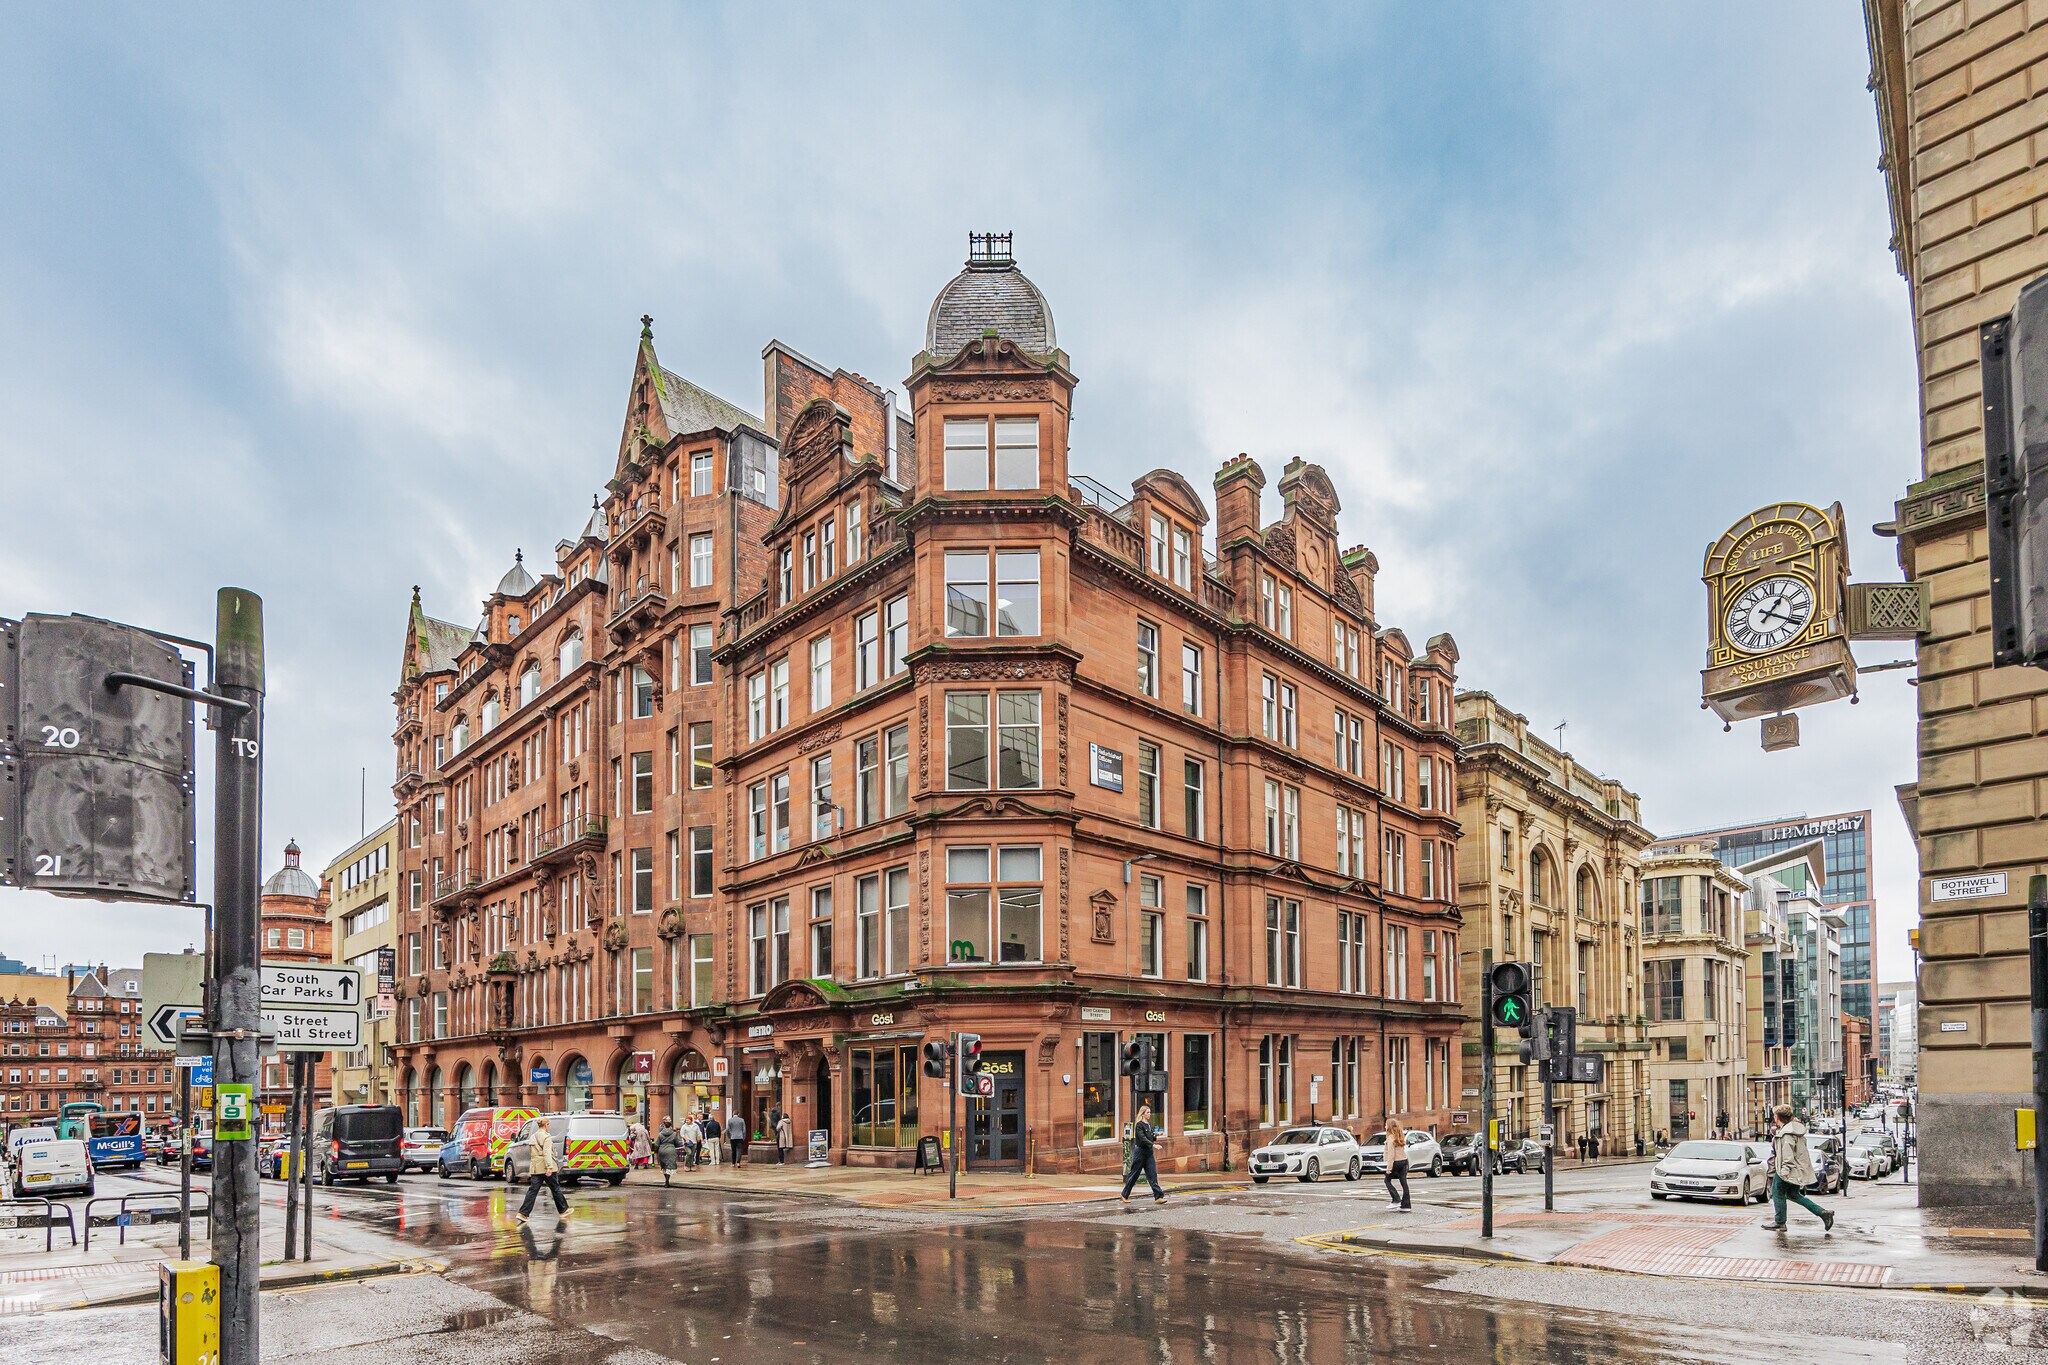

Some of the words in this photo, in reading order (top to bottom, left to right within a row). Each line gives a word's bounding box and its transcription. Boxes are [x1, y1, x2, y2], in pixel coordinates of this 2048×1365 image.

[1727, 525, 1774, 573] SCOTTISH
[1777, 523, 1811, 551] LEGAL
[1752, 543, 1783, 562] LIFE
[1730, 648, 1810, 676] ASSURANCE
[1740, 660, 1799, 684] SOCIETY
[41, 725, 80, 749] 20
[231, 737, 260, 759] T9
[34, 854, 62, 876] 21
[1941, 877, 1999, 890] BOTHWELL
[1949, 886, 1989, 896] STREET
[276, 972, 319, 985] South
[261, 984, 286, 996] Car
[294, 986, 333, 998] Parks
[283, 1015, 329, 1026] Street
[308, 1028, 352, 1039] Street
[225, 1094, 241, 1106] T
[224, 1107, 240, 1118] 9
[113, 1117, 138, 1136] X7
[97, 1140, 135, 1150] McGill's
